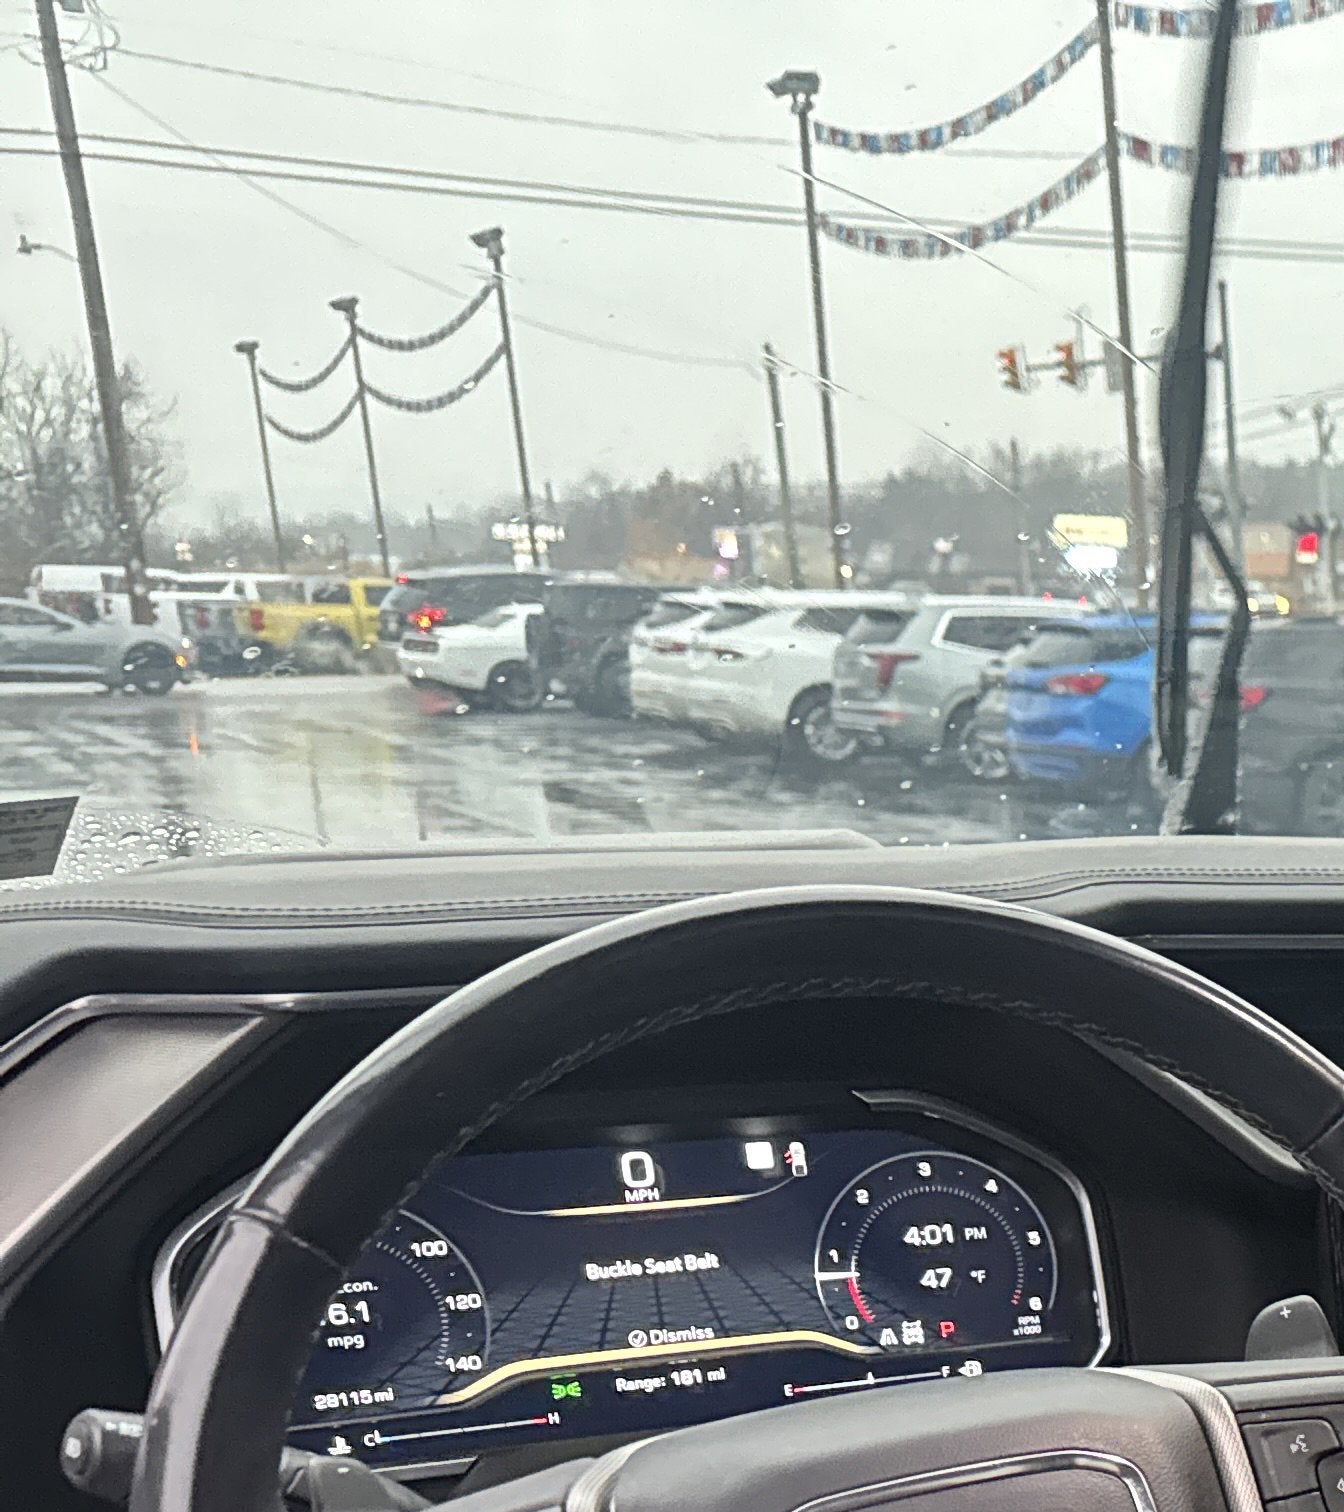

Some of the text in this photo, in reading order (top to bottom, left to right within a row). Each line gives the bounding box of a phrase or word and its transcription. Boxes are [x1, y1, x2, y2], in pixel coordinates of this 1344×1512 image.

[621, 1151, 655, 1188] 0
[917, 1162, 932, 1177] 3
[984, 1179, 999, 1193] 4
[624, 1187, 660, 1202] MPH
[855, 1189, 870, 1204] 2
[903, 1224, 988, 1247] 4:01 PM
[1027, 1231, 1041, 1246] 5
[410, 1240, 448, 1257] 100
[829, 1249, 839, 1263] 1
[585, 1252, 720, 1281] Buckle Seat Belt
[919, 1268, 953, 1289] 47
[337, 1280, 379, 1294] con.
[445, 1293, 482, 1311] 120
[1029, 1297, 1043, 1311] 6
[845, 1316, 859, 1330] 0
[1017, 1316, 1041, 1326] RPM
[649, 1326, 715, 1345] Dismiss
[939, 1321, 956, 1338] P
[1013, 1325, 1043, 1336] x1000
[327, 1334, 365, 1350] mpg
[445, 1355, 482, 1373] 140
[941, 1366, 951, 1377] F
[615, 1376, 667, 1393] Range:
[707, 1367, 726, 1382] mi
[784, 1384, 794, 1397] E
[314, 1388, 394, 1410] 28115 mi
[548, 1412, 560, 1425] H
